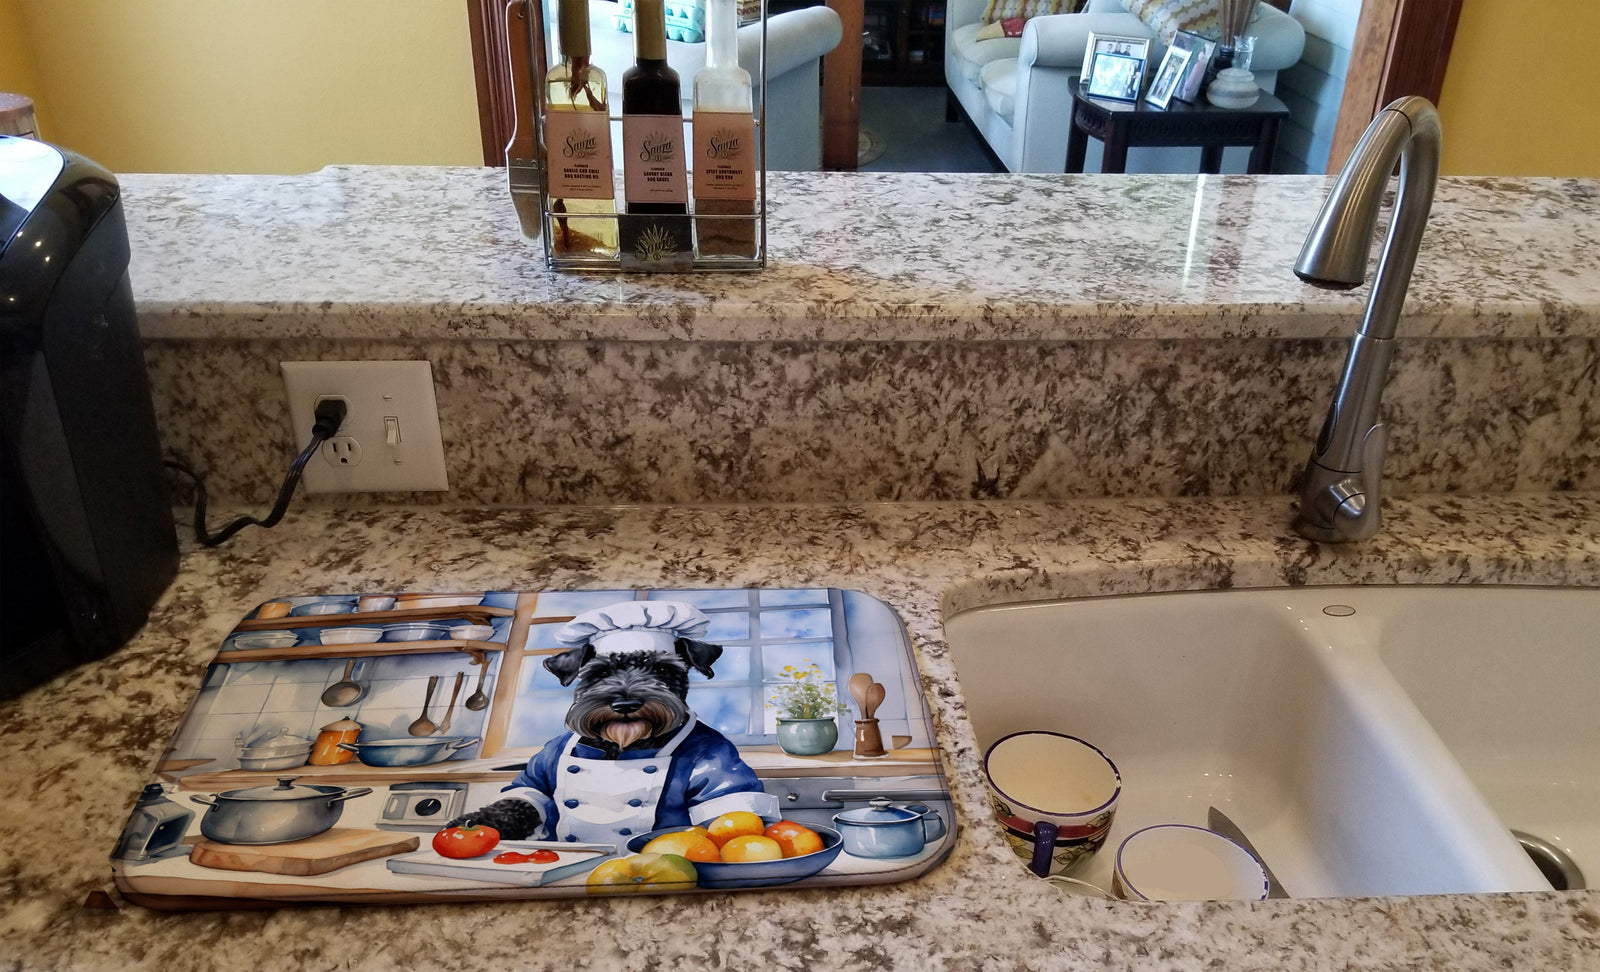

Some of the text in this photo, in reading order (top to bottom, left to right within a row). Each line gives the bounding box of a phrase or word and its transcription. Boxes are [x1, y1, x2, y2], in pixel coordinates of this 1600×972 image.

[563, 136, 597, 158] Sauza
[640, 140, 673, 161] Sauza
[707, 137, 740, 158] Sauza
